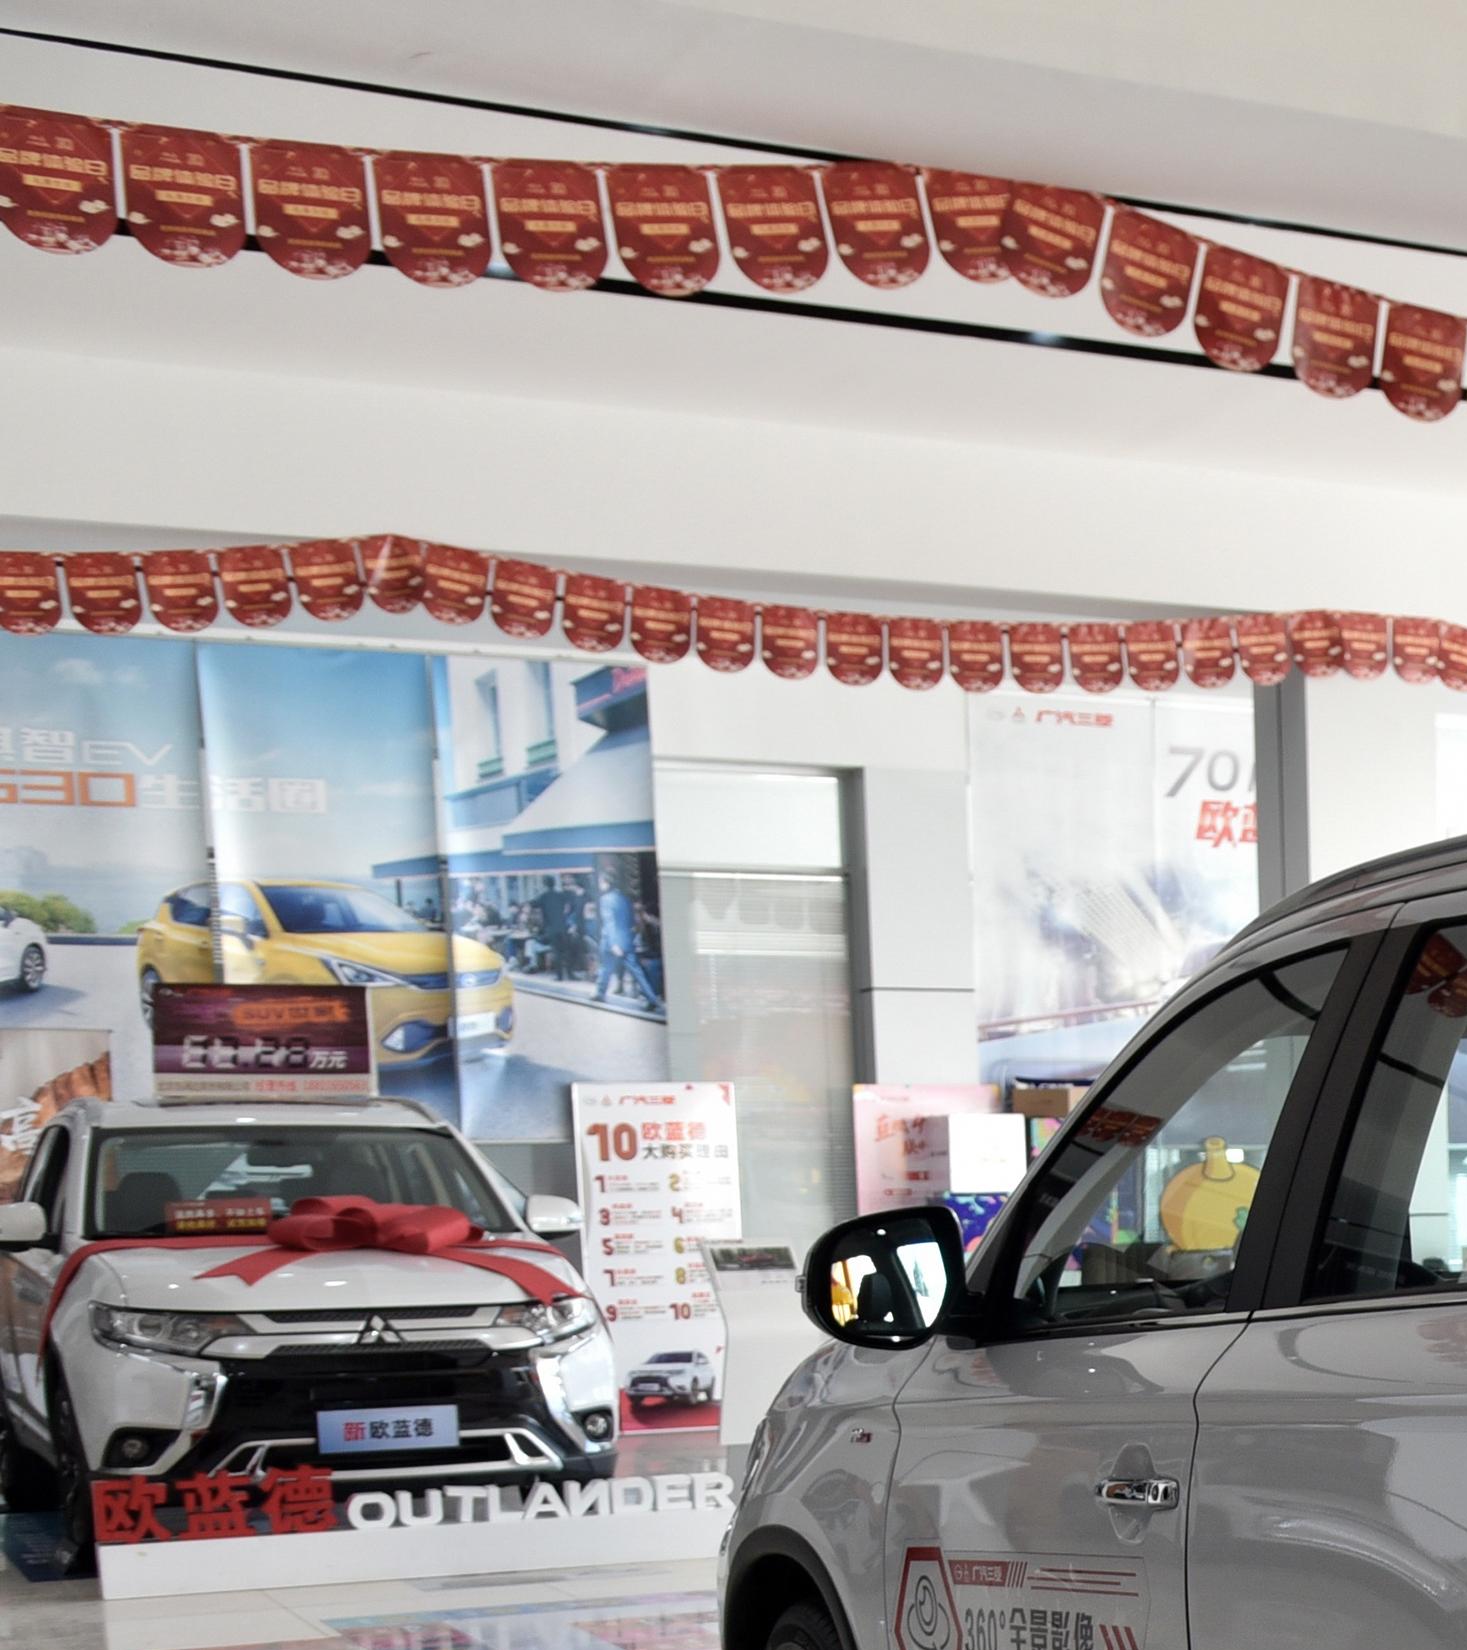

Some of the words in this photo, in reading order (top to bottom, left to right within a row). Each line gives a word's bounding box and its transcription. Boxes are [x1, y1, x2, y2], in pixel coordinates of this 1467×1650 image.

[0, 726, 173, 767] 智EV
[641, 1121, 706, 1141] 欧蓝德
[586, 1122, 638, 1162] 10
[643, 1142, 730, 1160] 大购买理由
[594, 1174, 606, 1193] 1
[668, 1173, 681, 1192] 2
[599, 1207, 611, 1226] 3
[671, 1206, 684, 1224] 4
[602, 1237, 614, 1256] 5
[674, 1236, 685, 1254] 6
[604, 1268, 617, 1287] 7
[675, 1267, 686, 1285] 8
[605, 1304, 618, 1322] 9
[669, 1302, 692, 1320] 10
[343, 1418, 434, 1441] 新欧蓝德
[91, 1463, 339, 1544] 欧蓝德
[346, 1471, 735, 1532] OUTLANDER
